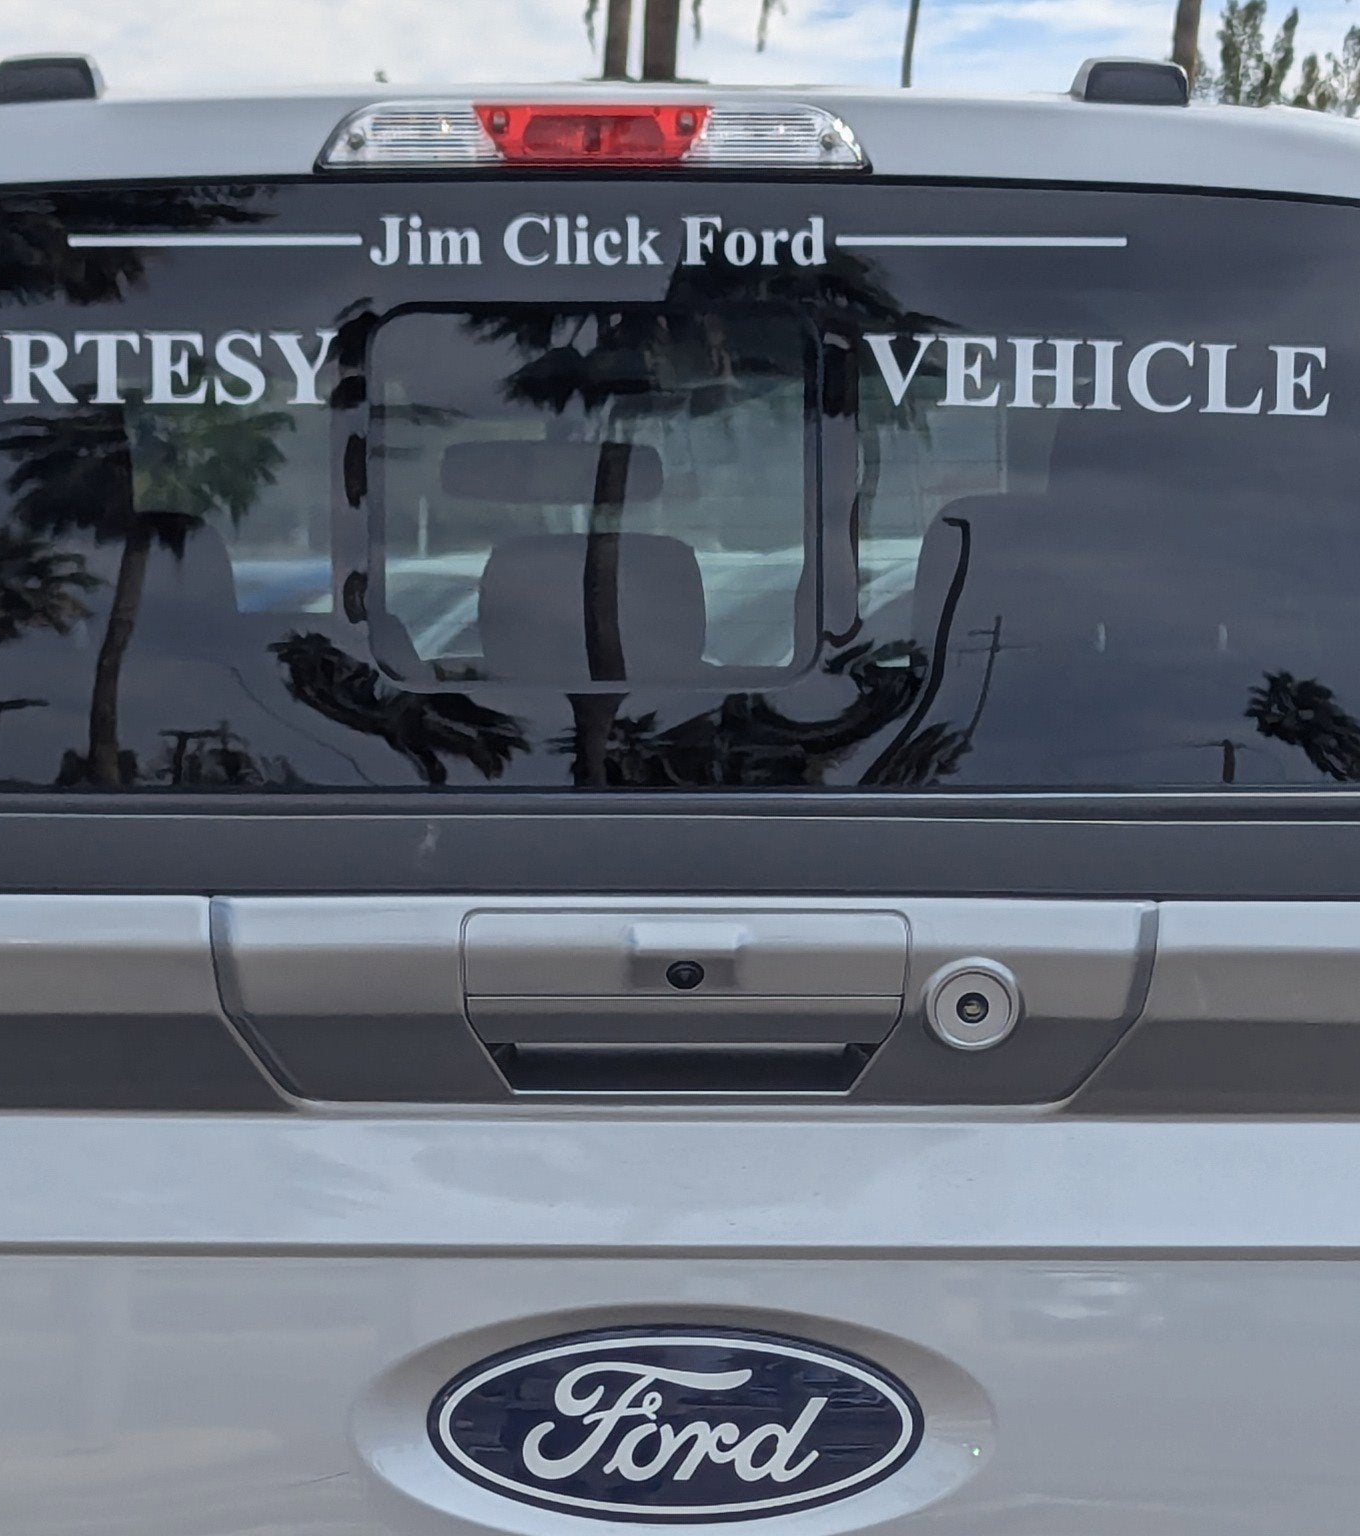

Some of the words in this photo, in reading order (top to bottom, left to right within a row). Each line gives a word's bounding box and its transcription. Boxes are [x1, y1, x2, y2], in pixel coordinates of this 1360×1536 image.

[369, 214, 482, 266] Jim
[502, 212, 665, 266] Click
[679, 213, 828, 266] Ford
[862, 333, 1332, 417] VEHICLE
[519, 1360, 829, 1484] Ford
